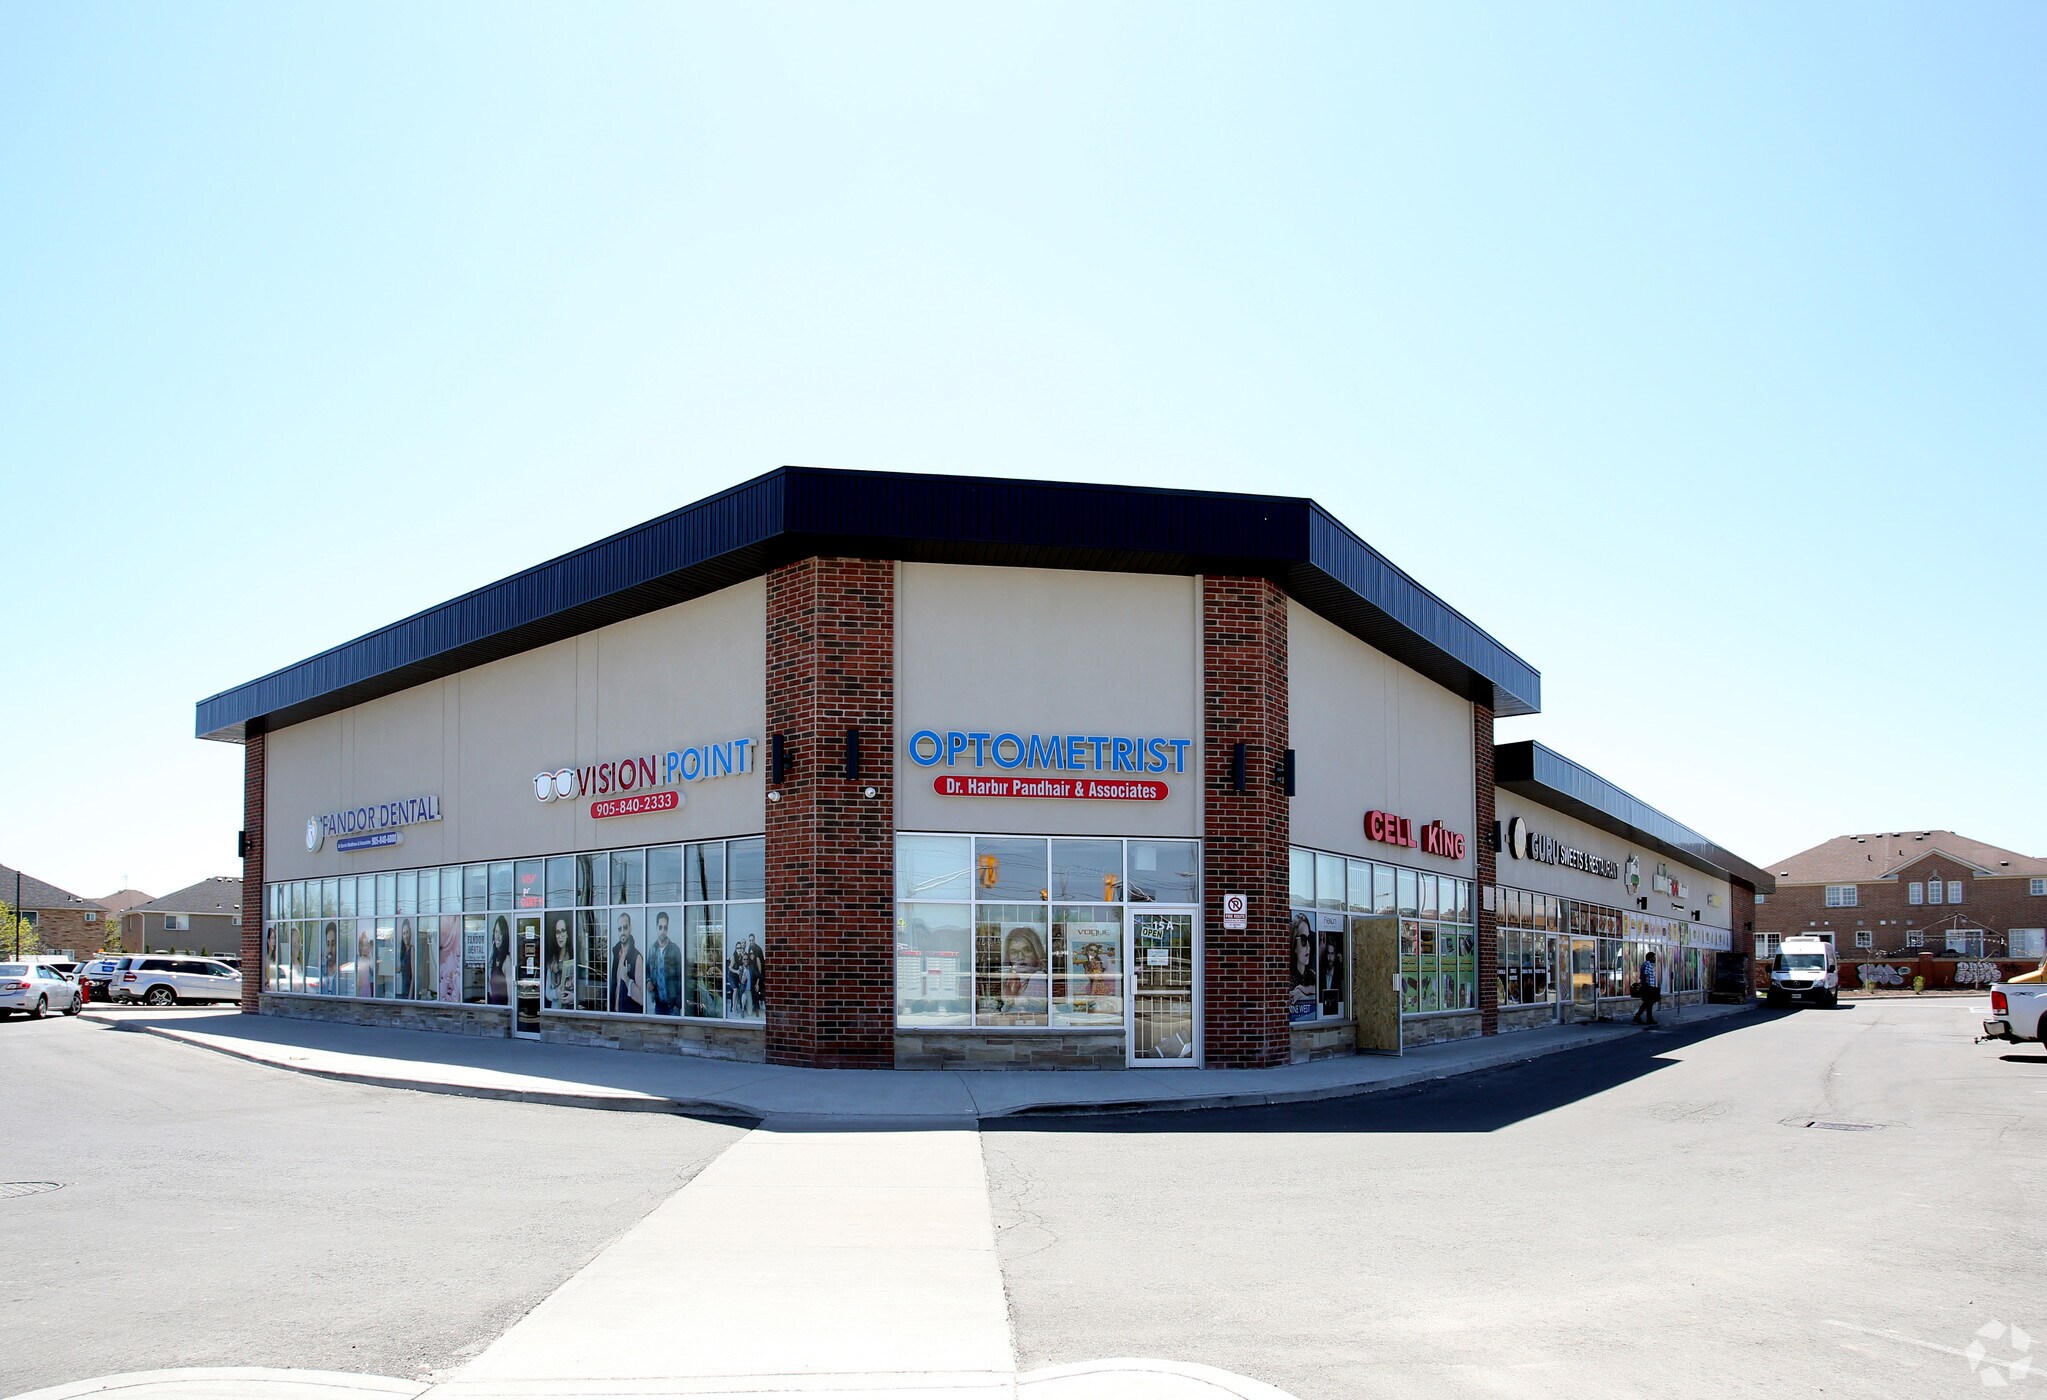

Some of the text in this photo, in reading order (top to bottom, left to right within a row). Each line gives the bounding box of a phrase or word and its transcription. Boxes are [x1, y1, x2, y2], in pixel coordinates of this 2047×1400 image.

[576, 738, 750, 796] VISION POINT
[909, 729, 1191, 774] OPTOMETRIST
[596, 793, 672, 817] 905-840-2333
[946, 778, 964, 794] Dr.
[1013, 779, 1070, 796] Pandhair
[1075, 781, 1084, 797] &
[1089, 781, 1157, 798] Associates
[322, 796, 435, 836] FANDOR DENTAL
[1370, 809, 1466, 860] CELL KING
[1531, 832, 1560, 866] GURU
[1560, 845, 1584, 870] SWEETS
[1589, 855, 1619, 879] RESTAURANT
[1077, 929, 1110, 937] VOGUE
[1142, 928, 1163, 938] OPEN
